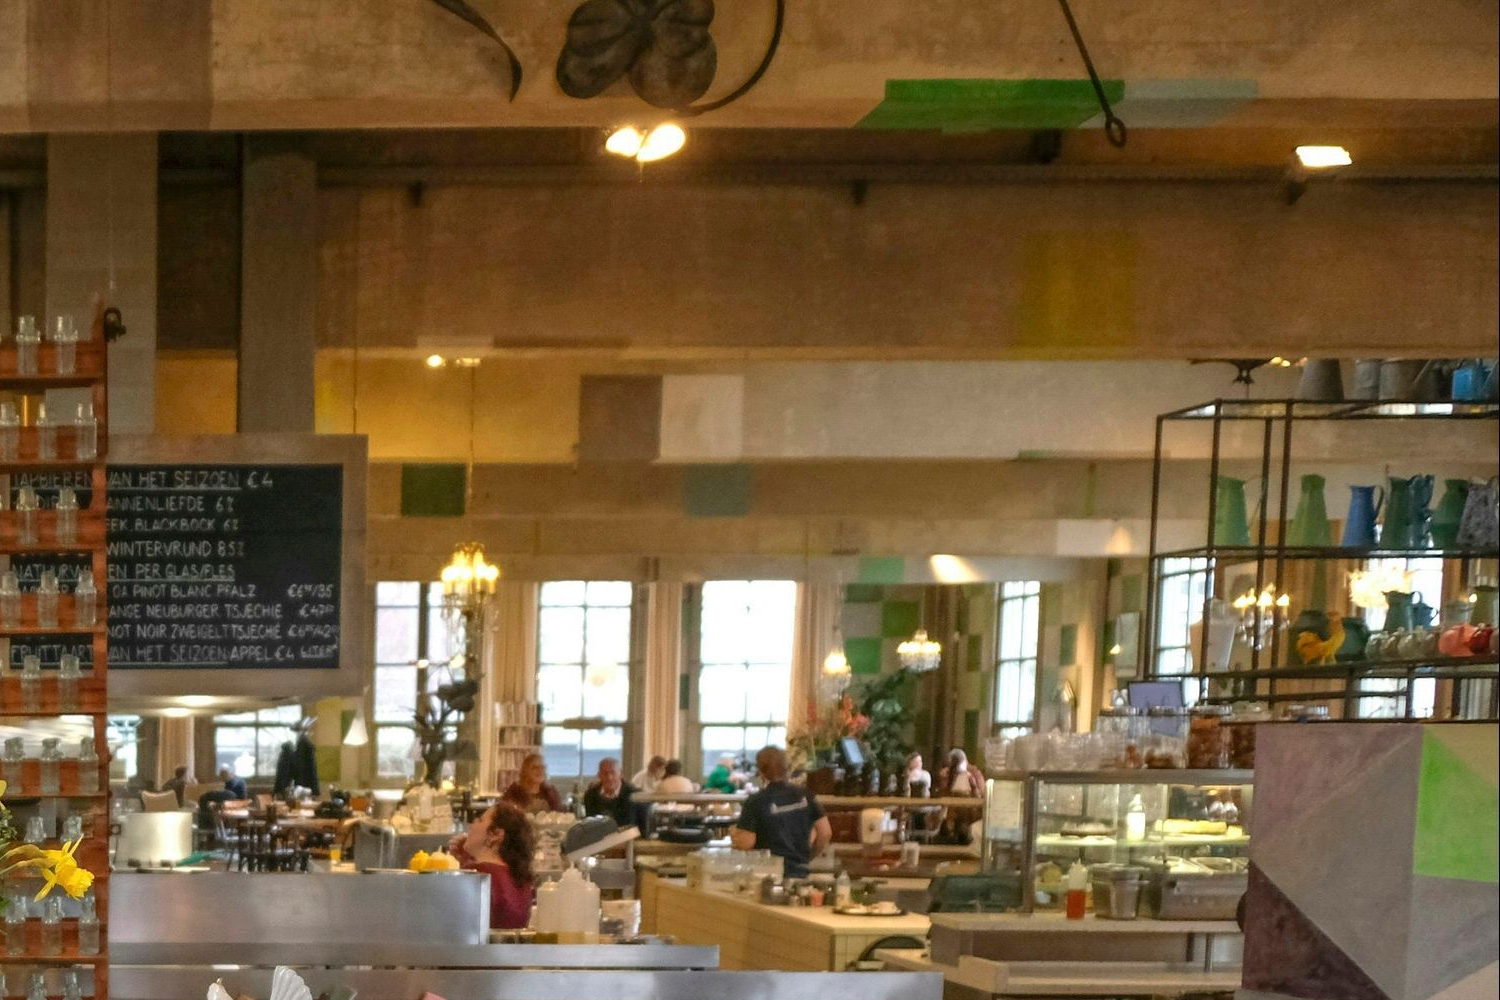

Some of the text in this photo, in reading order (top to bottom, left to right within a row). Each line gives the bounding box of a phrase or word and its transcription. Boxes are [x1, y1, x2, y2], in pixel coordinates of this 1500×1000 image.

[139, 471, 165, 488] HET
[174, 471, 239, 488] SEIZOEN
[106, 496, 205, 511] ANNENLIEFDE
[134, 518, 215, 531] BLACKBOCK
[135, 563, 161, 579] PER
[133, 584, 165, 598] PINOT
[170, 584, 211, 598] BLANC
[108, 603, 141, 618] ANGE
[106, 624, 132, 639] NOT
[137, 624, 167, 639] NOIR
[136, 644, 165, 662] HET
